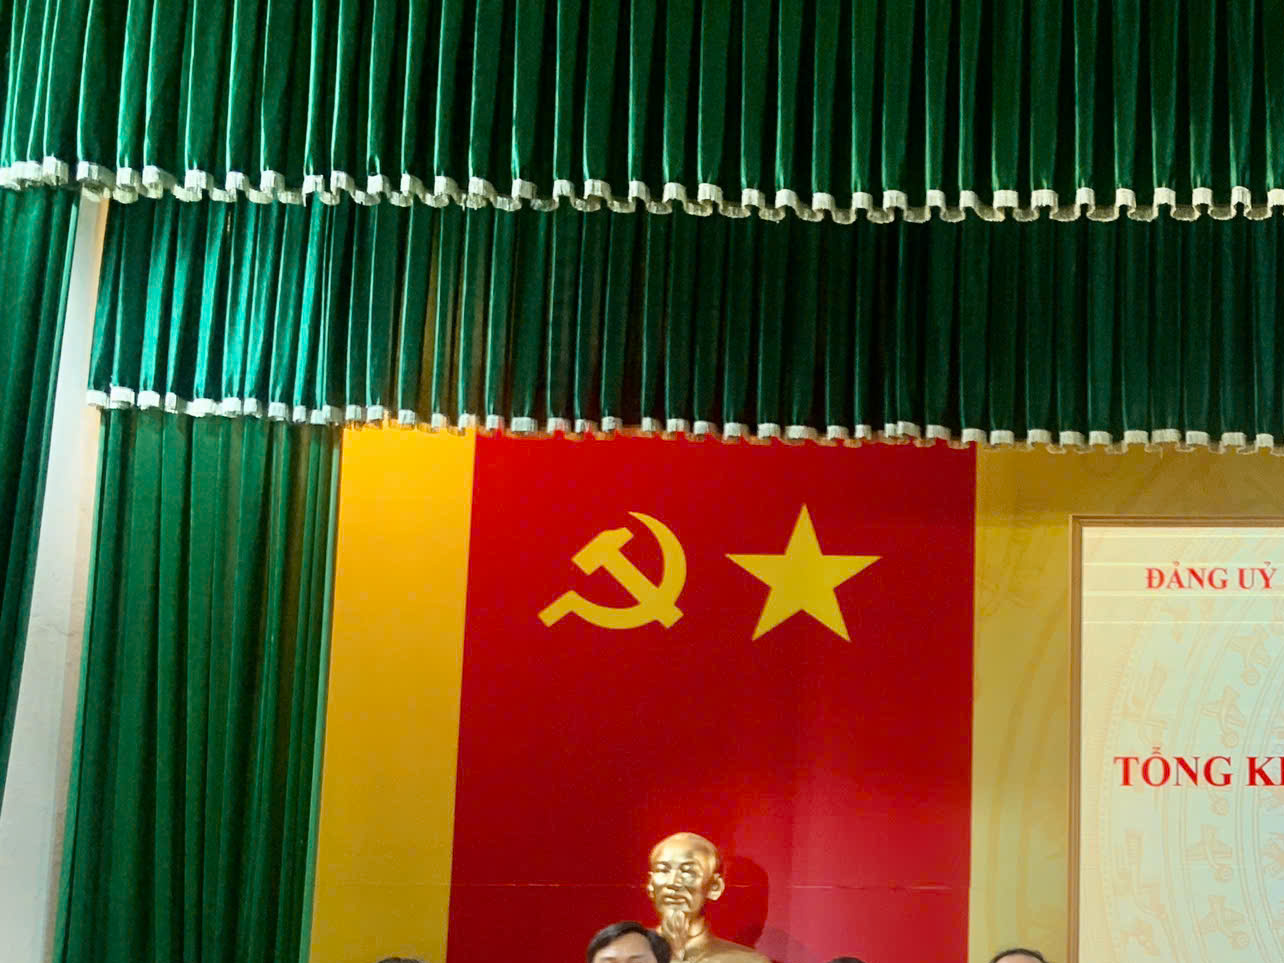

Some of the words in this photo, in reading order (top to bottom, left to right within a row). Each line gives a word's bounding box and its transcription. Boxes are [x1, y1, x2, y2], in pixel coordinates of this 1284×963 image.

[1145, 561, 1228, 590] ĐẢNG
[1238, 561, 1277, 590] UỶ
[1113, 746, 1233, 787] TỔNG
